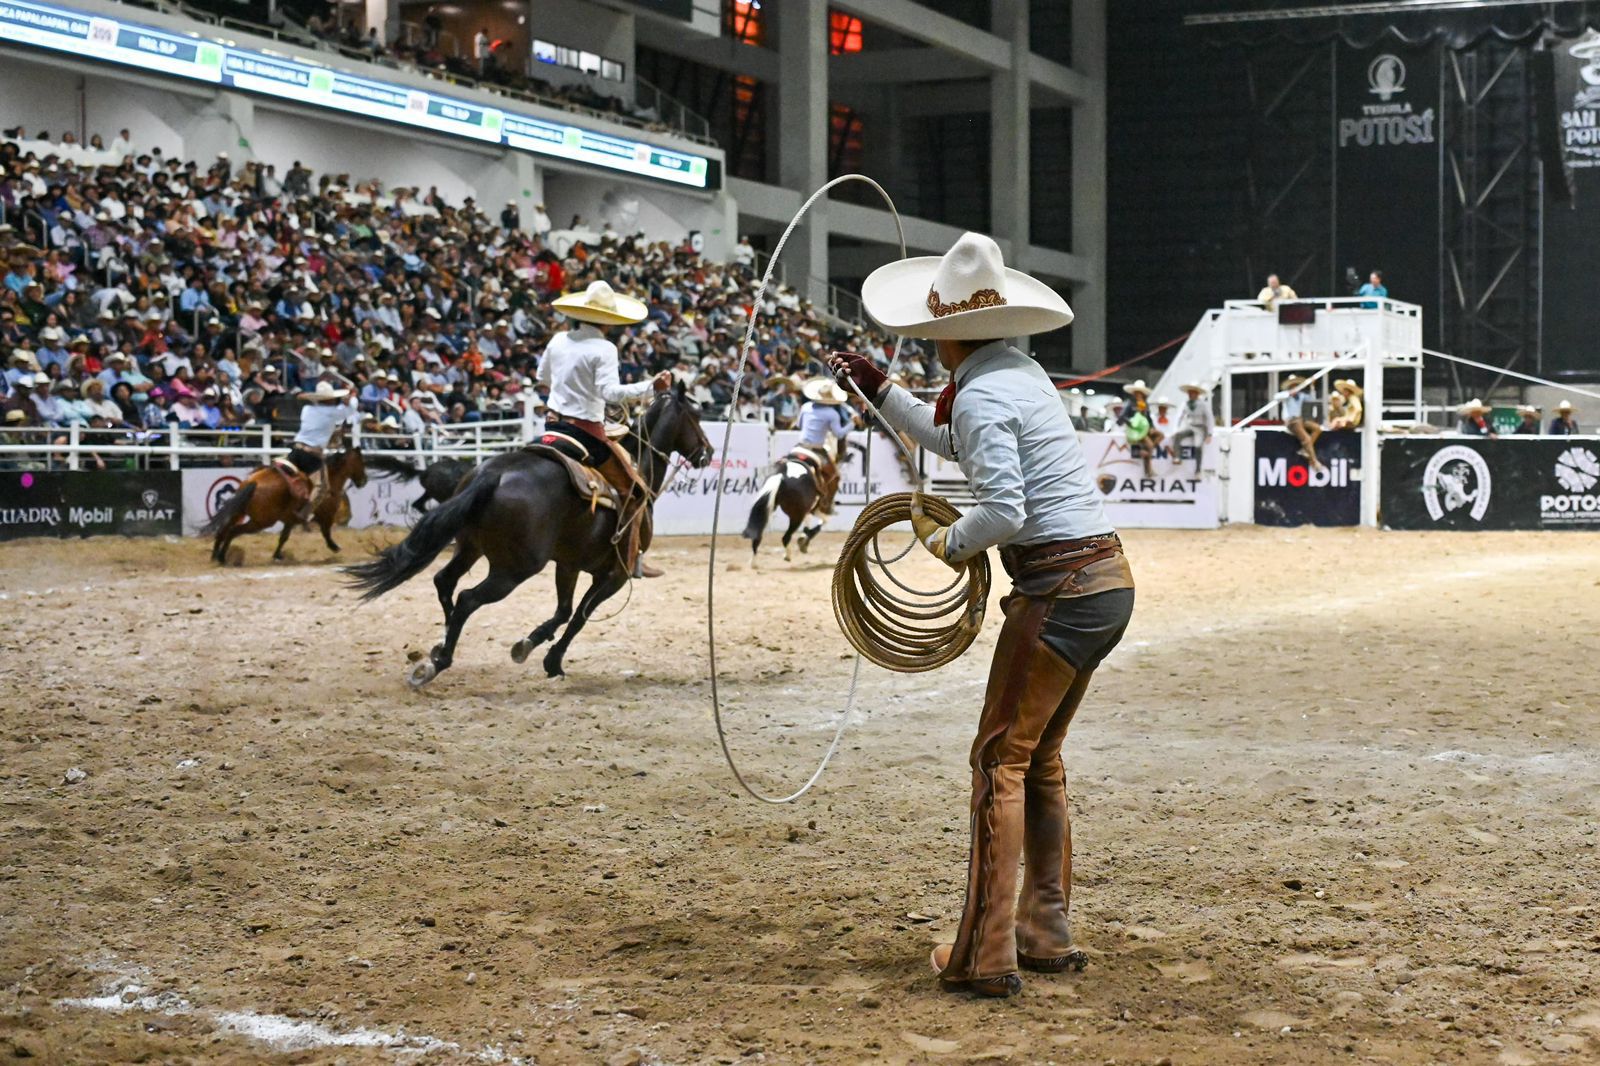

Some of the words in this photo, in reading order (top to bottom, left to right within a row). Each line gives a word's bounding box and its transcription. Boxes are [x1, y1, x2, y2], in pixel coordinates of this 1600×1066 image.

[1561, 110, 1596, 128] SAN
[1258, 457, 1347, 487] Mobil
[1119, 478, 1201, 493] ARIAT
[68, 507, 113, 527] Mobil
[123, 509, 175, 521] ARIAT
